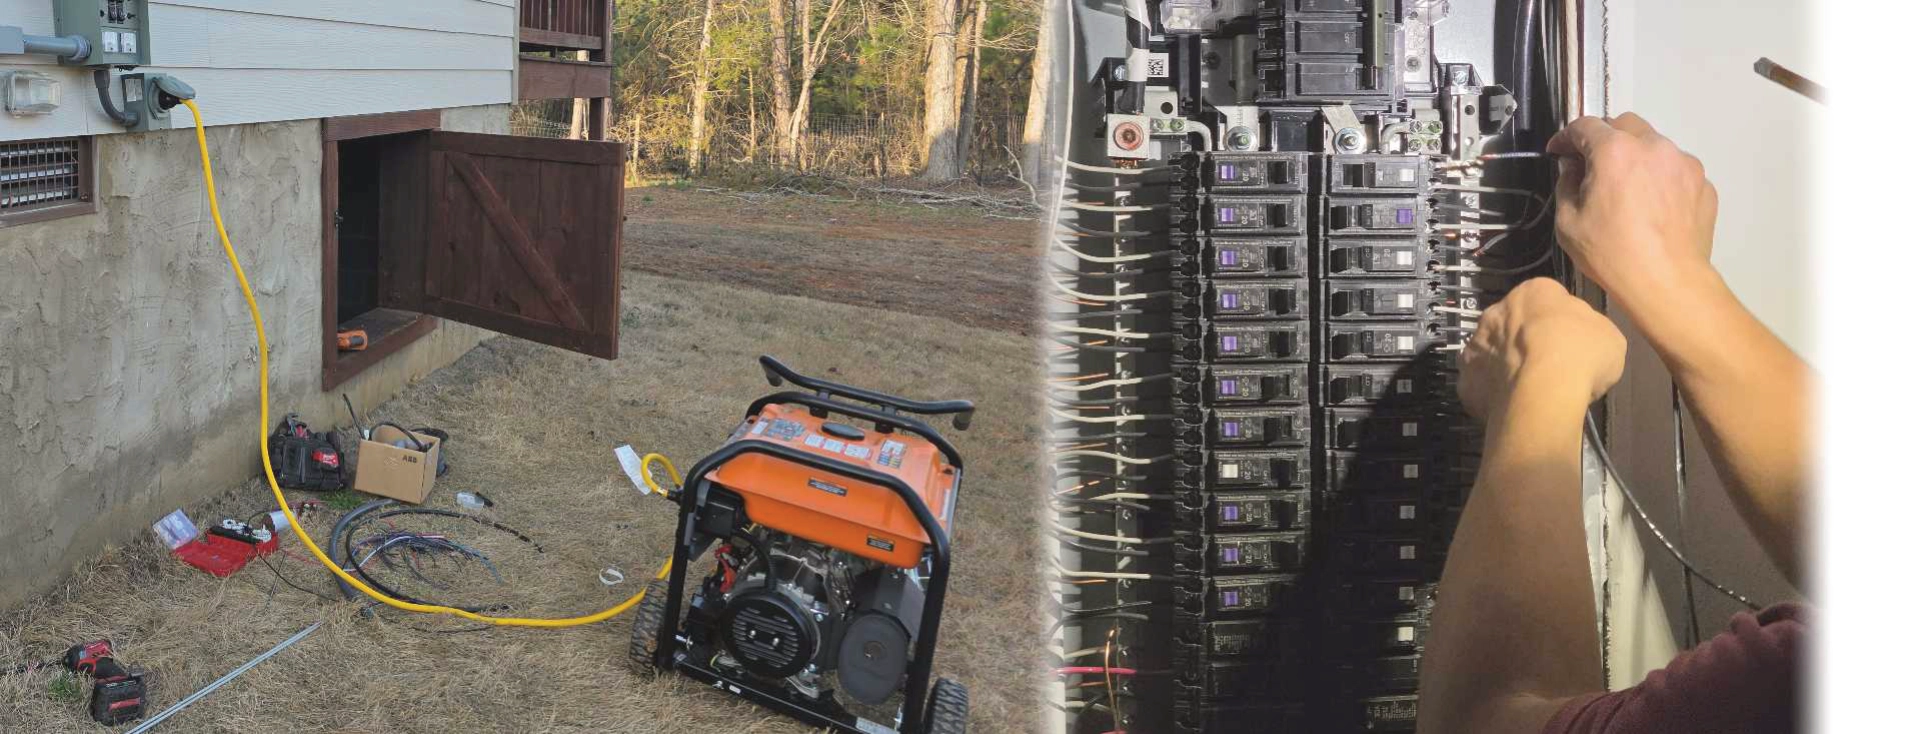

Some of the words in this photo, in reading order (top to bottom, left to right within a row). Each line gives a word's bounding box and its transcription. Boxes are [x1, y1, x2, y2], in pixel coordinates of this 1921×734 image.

[1242, 171, 1249, 181] 20
[1242, 215, 1248, 224] 20
[1384, 248, 1391, 258] 20
[1244, 301, 1250, 310] 20
[1385, 333, 1392, 342] 20
[1242, 388, 1249, 397] 20
[1244, 472, 1252, 480] 20
[1246, 513, 1252, 522] 20
[1246, 555, 1252, 564] 20
[1245, 598, 1252, 606] 20
